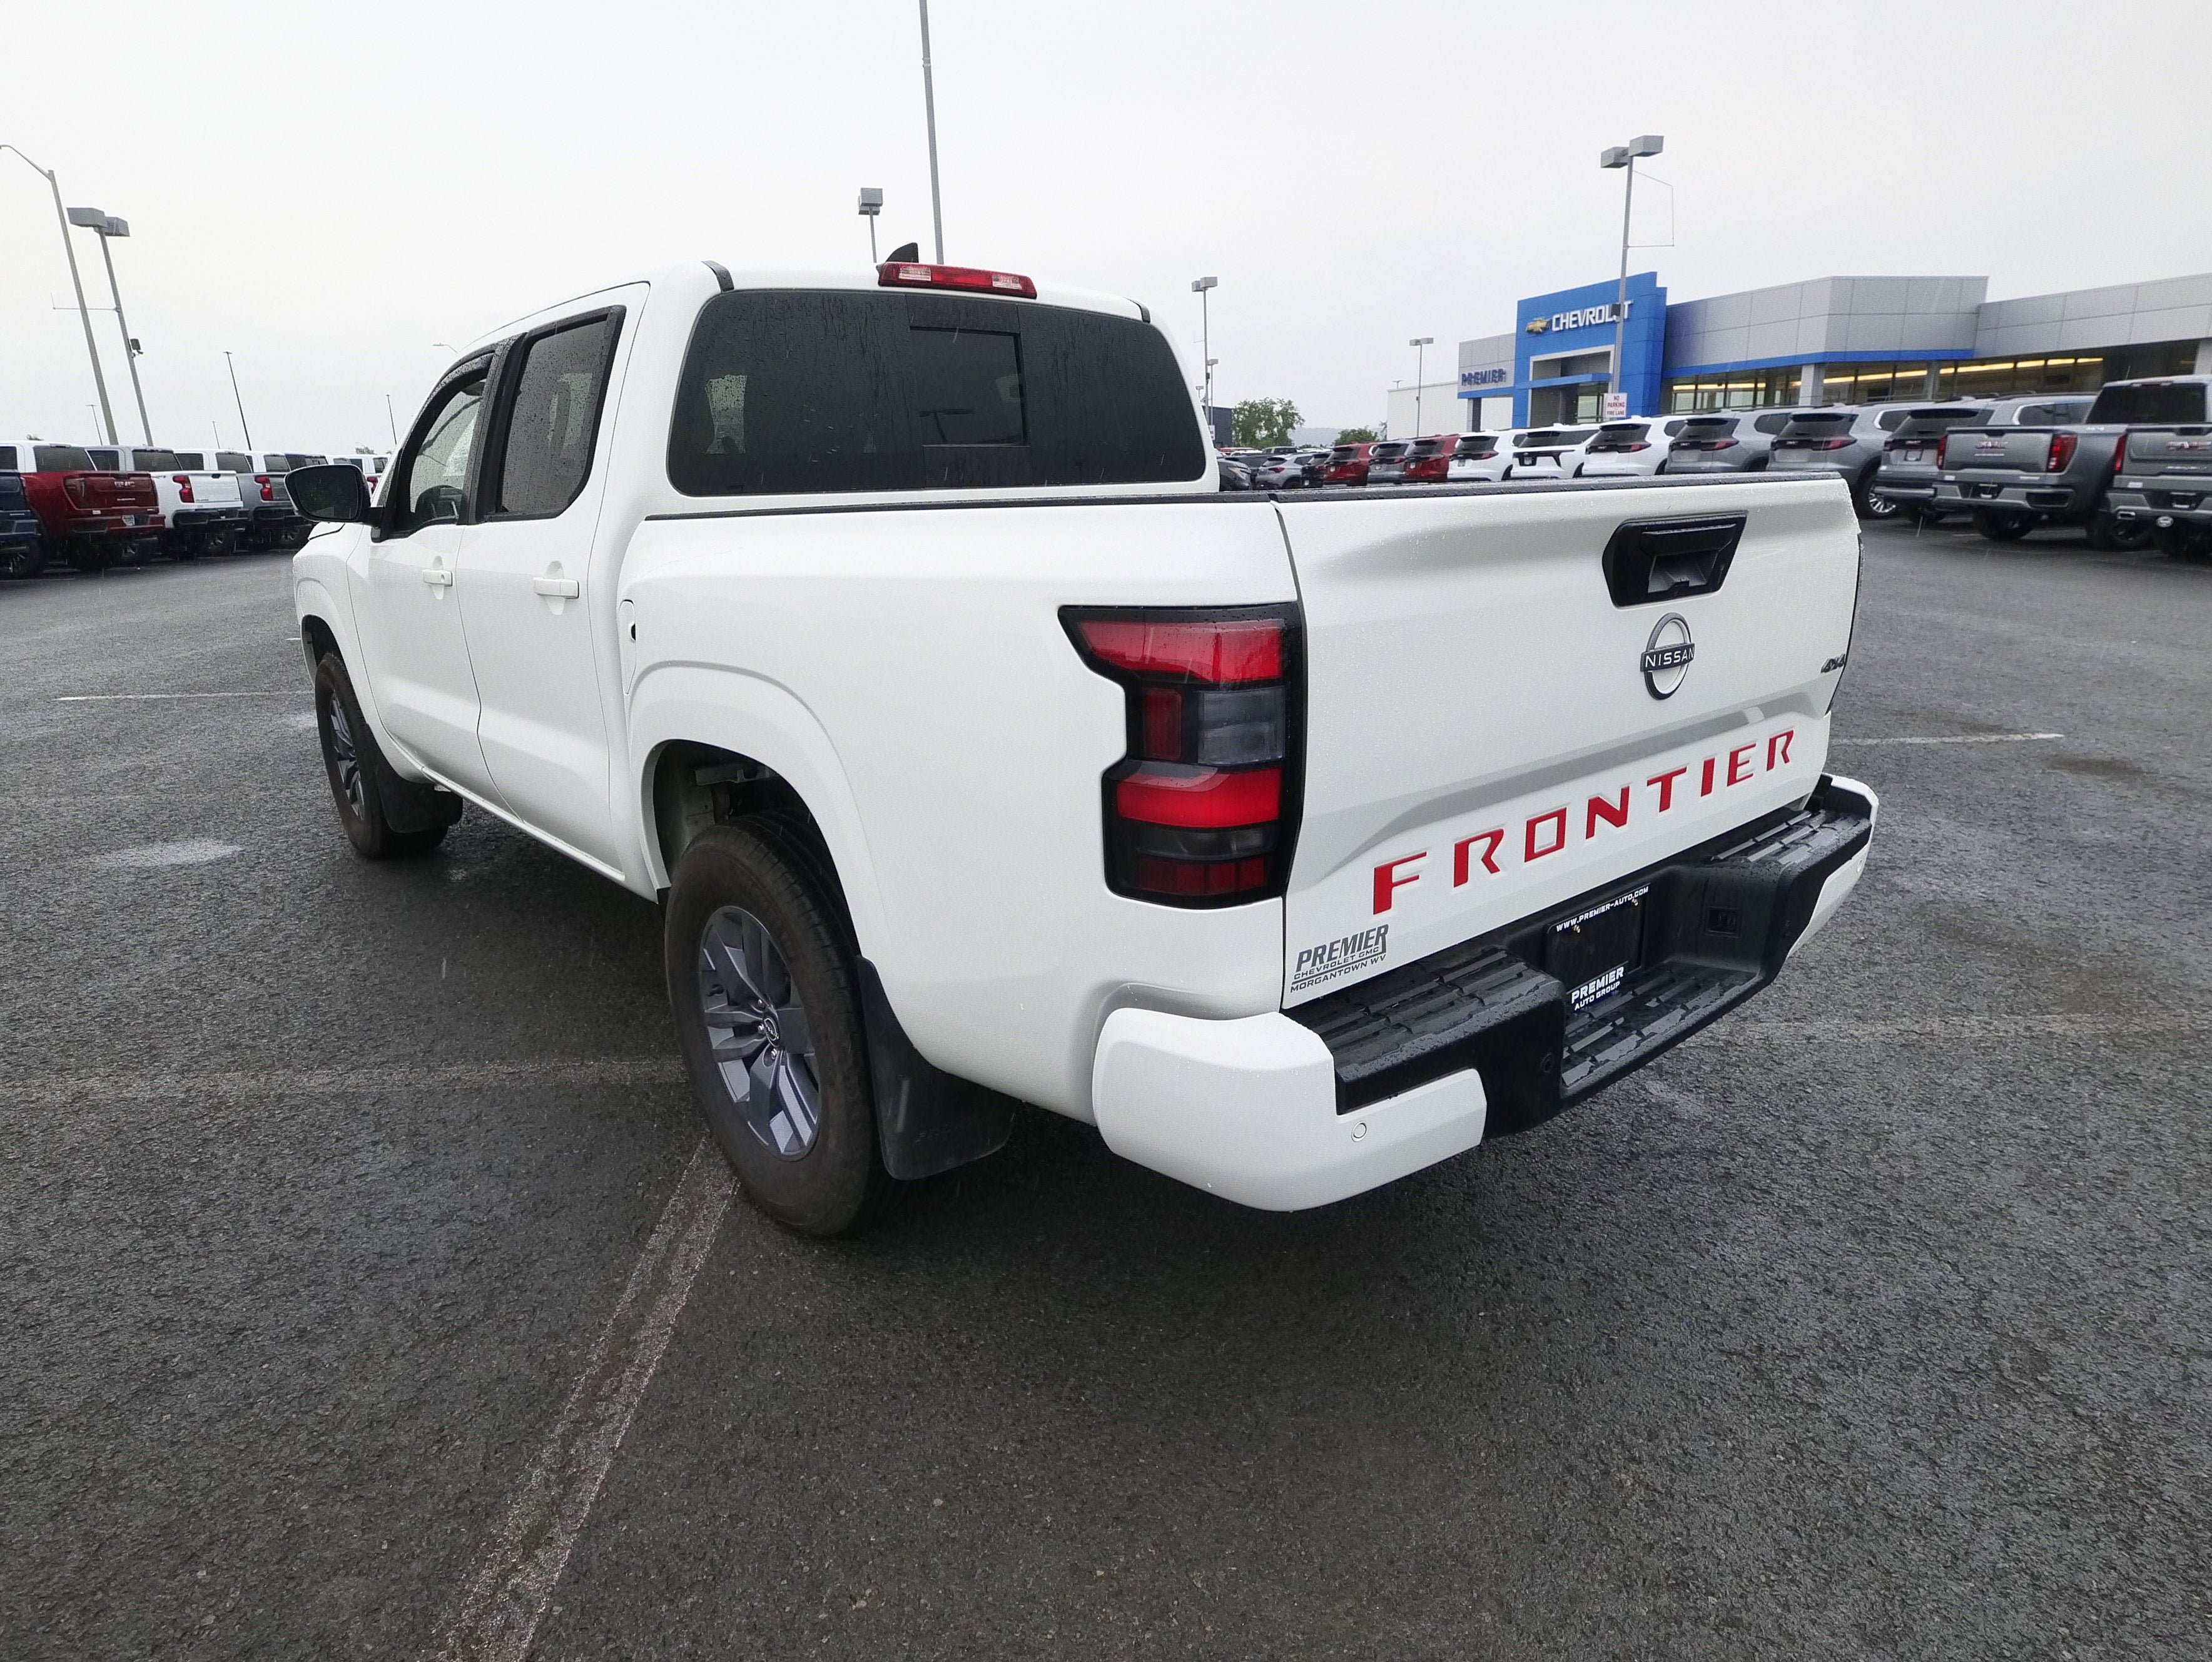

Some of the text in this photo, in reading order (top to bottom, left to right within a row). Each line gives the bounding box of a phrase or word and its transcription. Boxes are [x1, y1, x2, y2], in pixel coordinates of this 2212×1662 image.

[1551, 300, 1632, 332] CHEVROLT
[1461, 368, 1506, 386] PREMIER
[1645, 647, 1694, 668] NISSAN
[1373, 730, 1793, 915] FRONTIER
[1556, 886, 1649, 932] WWW.PREMIER-AUTO.COM
[1294, 947, 1379, 980] CHEVROLET GMC
[1296, 924, 1389, 973] PREMIER
[1291, 954, 1386, 993] MORGANTOWN WV
[1571, 966, 1625, 1004] PREMIER
[1575, 981, 1621, 1011] AUTO GROUP
